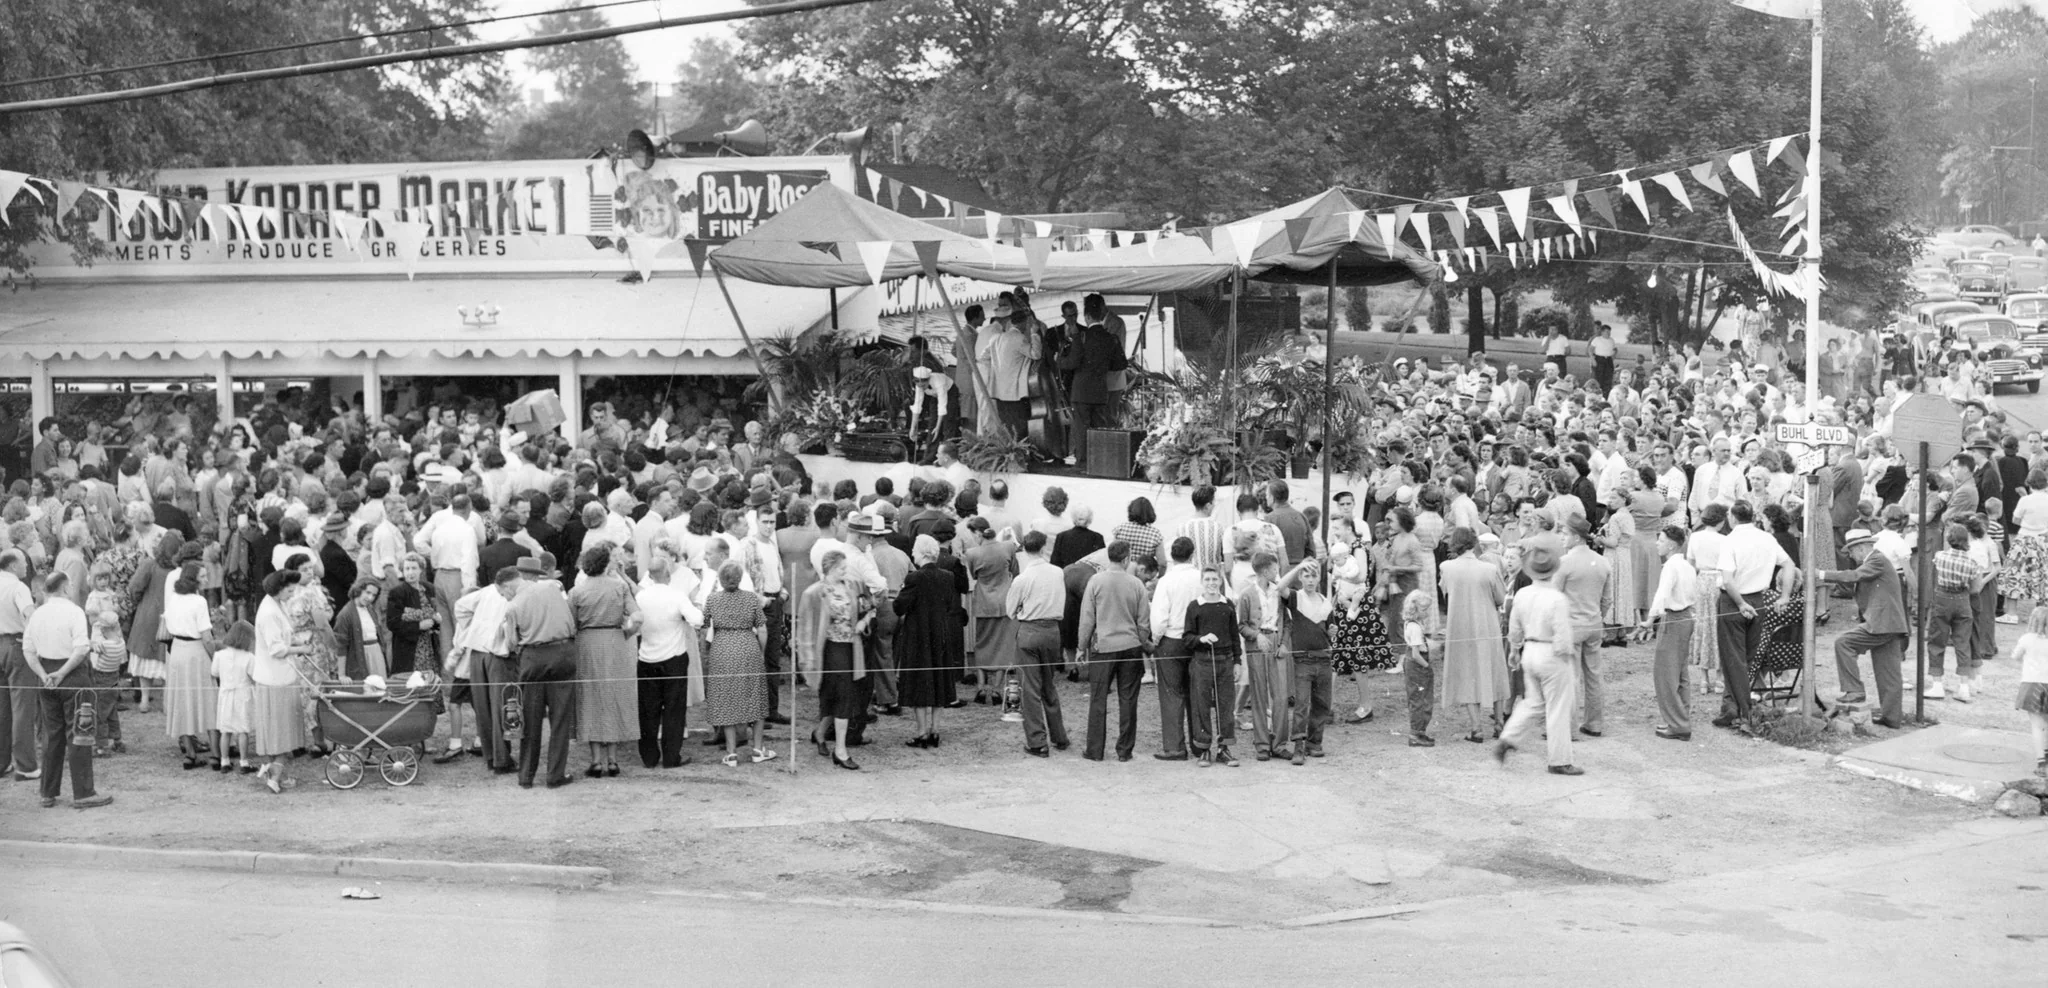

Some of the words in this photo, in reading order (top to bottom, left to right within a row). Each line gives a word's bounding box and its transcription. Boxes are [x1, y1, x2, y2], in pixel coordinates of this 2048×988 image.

[226, 179, 384, 240] KORNER
[398, 175, 566, 237] MARKET
[702, 174, 764, 219] Baby
[766, 173, 818, 214] Ros
[115, 245, 192, 261] MEATS
[227, 242, 334, 259] PRODUCE
[371, 240, 507, 257] GRCERIES
[1781, 426, 1809, 440] BUHL
